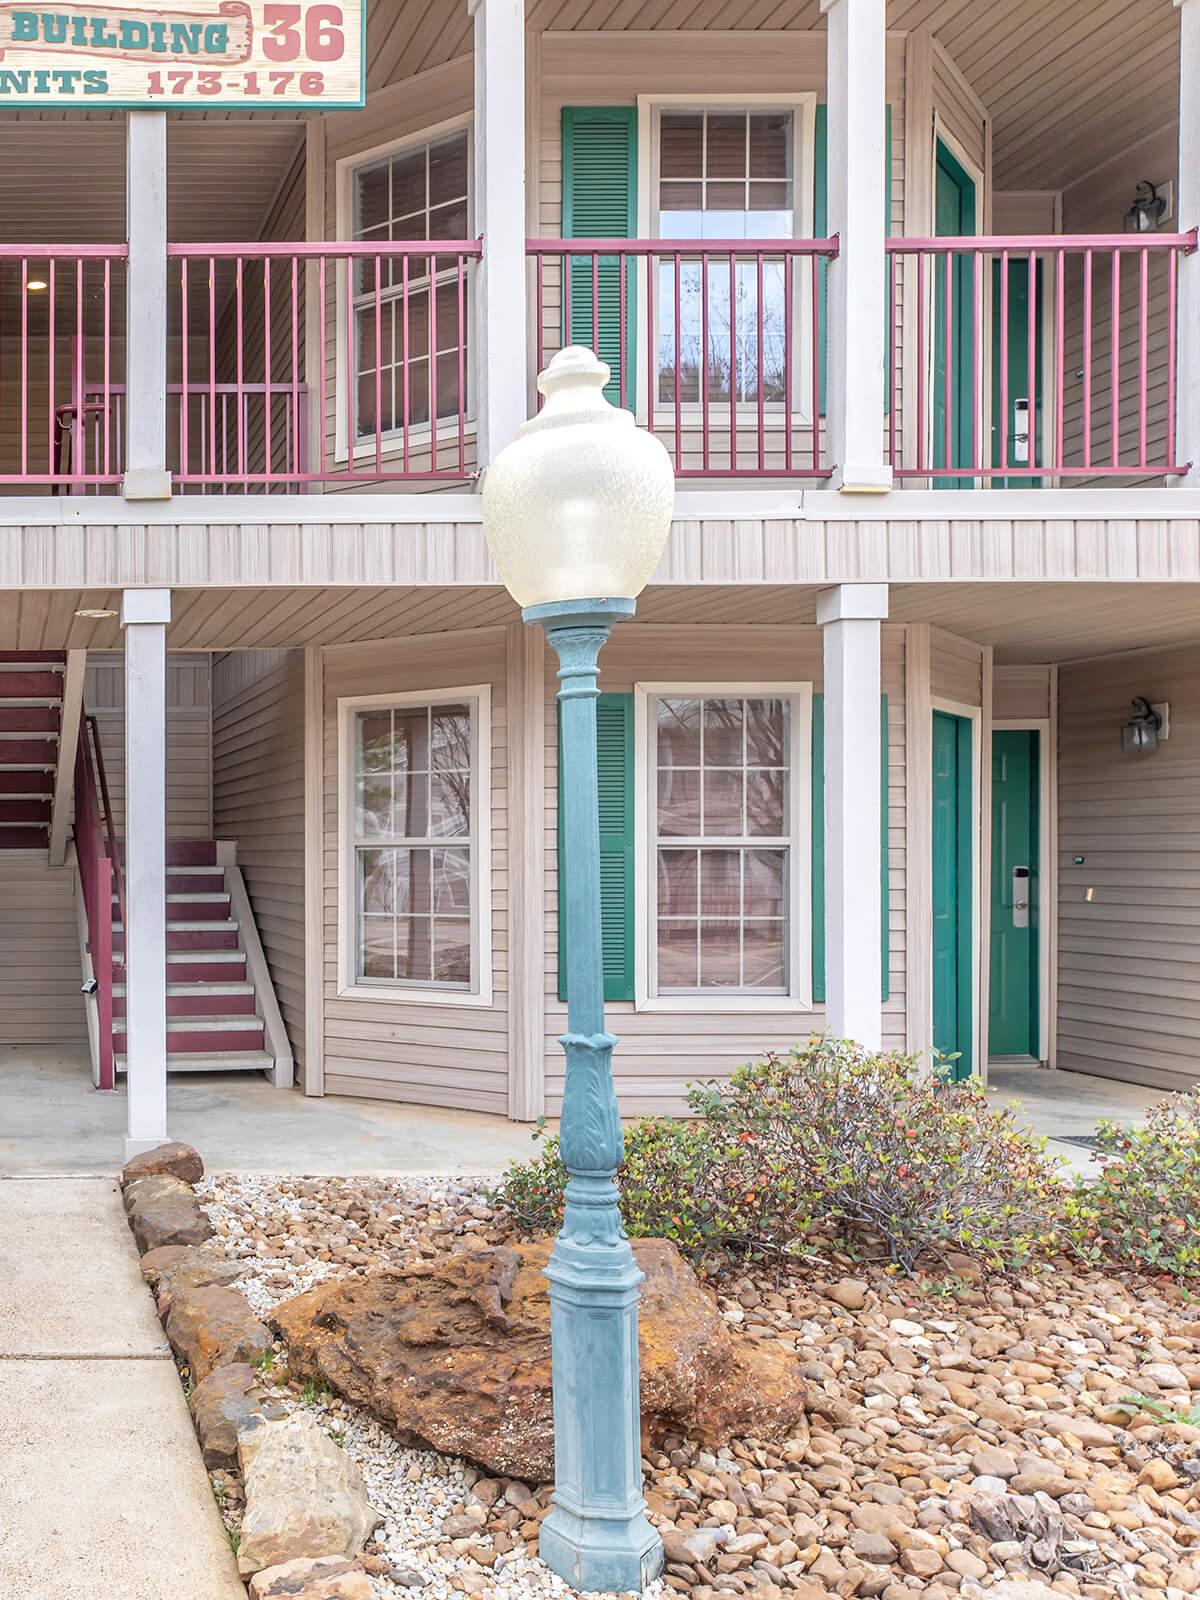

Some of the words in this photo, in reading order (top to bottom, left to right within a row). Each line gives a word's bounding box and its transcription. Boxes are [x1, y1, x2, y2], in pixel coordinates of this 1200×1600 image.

[11, 11, 229, 54] BUILDING
[262, 4, 345, 62] 36
[147, 71, 325, 95] 173-176
